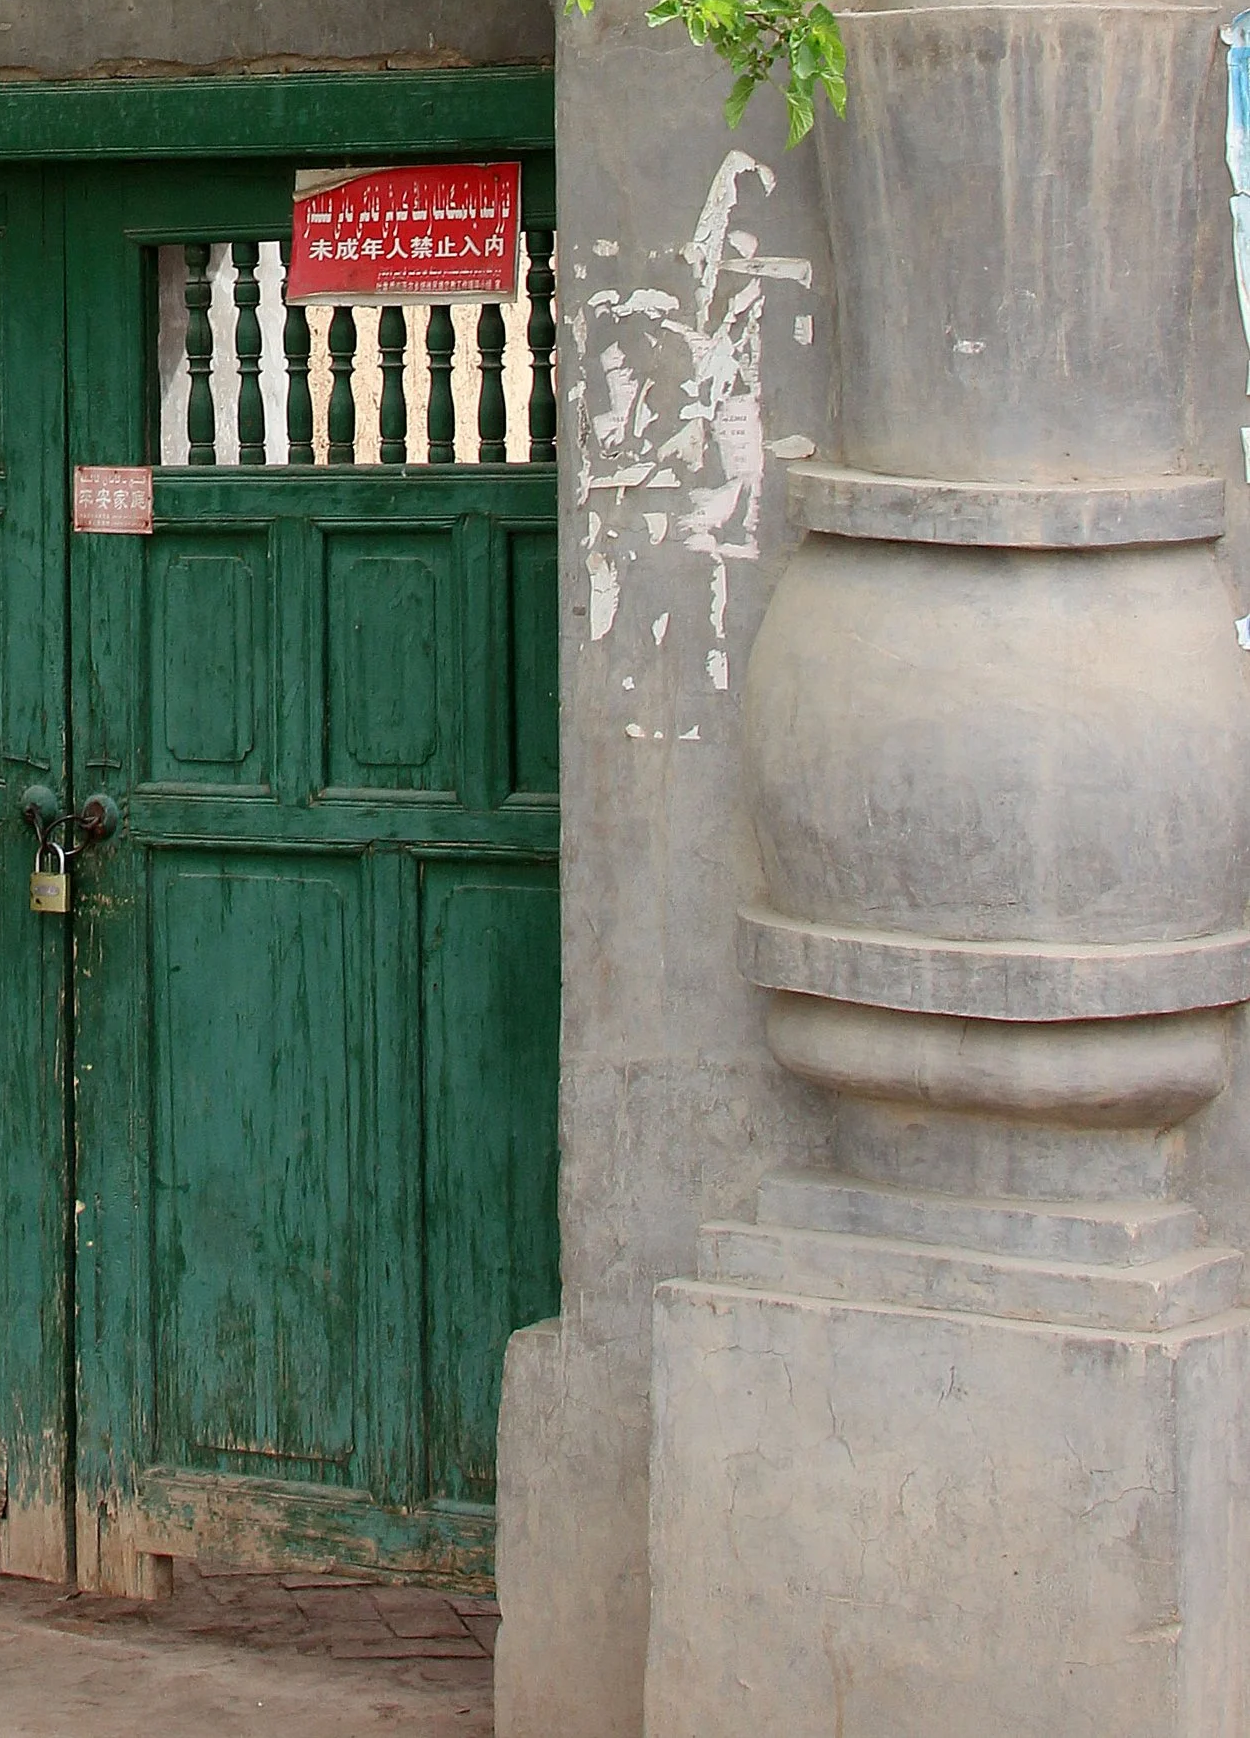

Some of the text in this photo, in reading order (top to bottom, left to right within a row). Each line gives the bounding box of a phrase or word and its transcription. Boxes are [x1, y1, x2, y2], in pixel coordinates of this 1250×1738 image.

[309, 233, 505, 261] 未成年人禁止入内
[78, 488, 147, 510] 平安家庭
